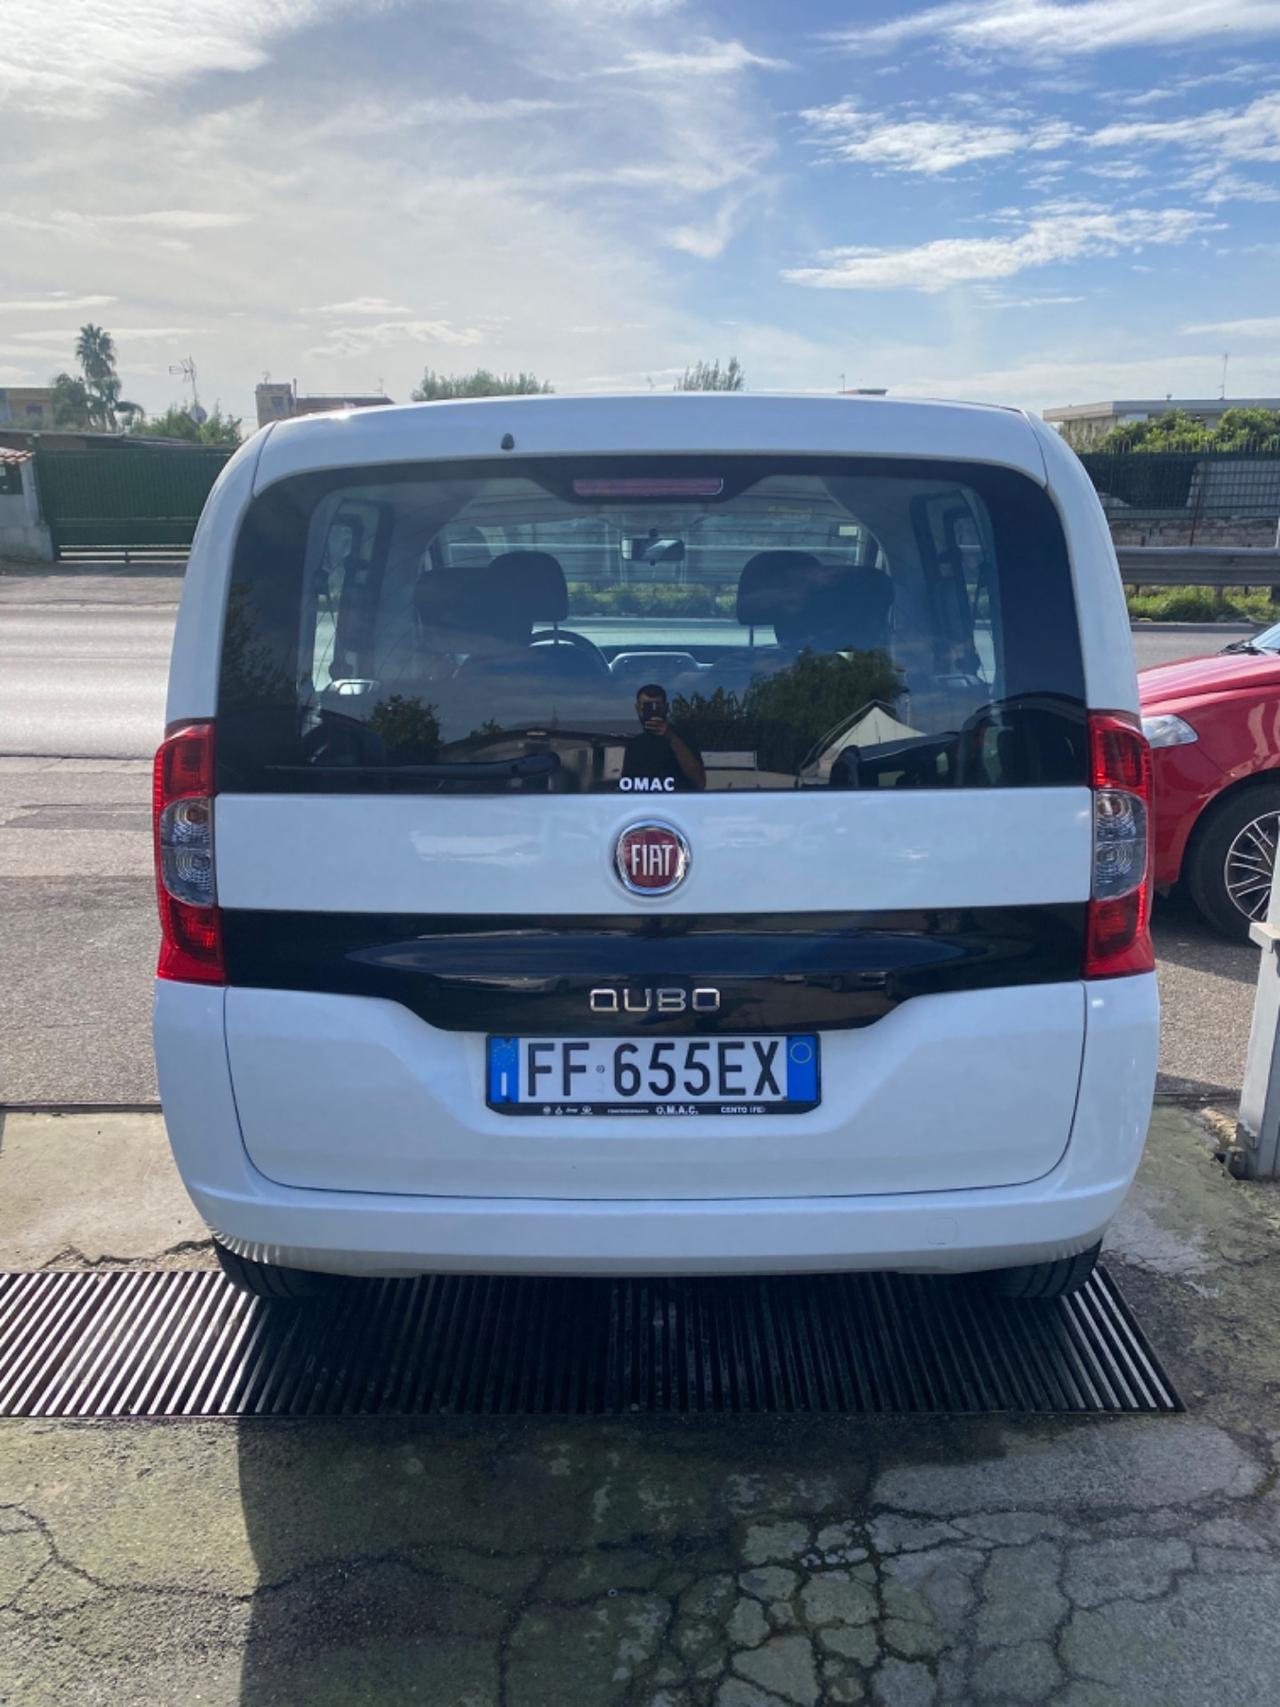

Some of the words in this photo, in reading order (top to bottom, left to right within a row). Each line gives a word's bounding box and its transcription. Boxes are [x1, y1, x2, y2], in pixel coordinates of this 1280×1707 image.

[619, 777, 675, 791] OMAC
[631, 844, 673, 876] FIAT
[590, 988, 721, 1012] QUBO
[501, 1071, 508, 1097] I
[720, 1106, 748, 1114] CENTO
